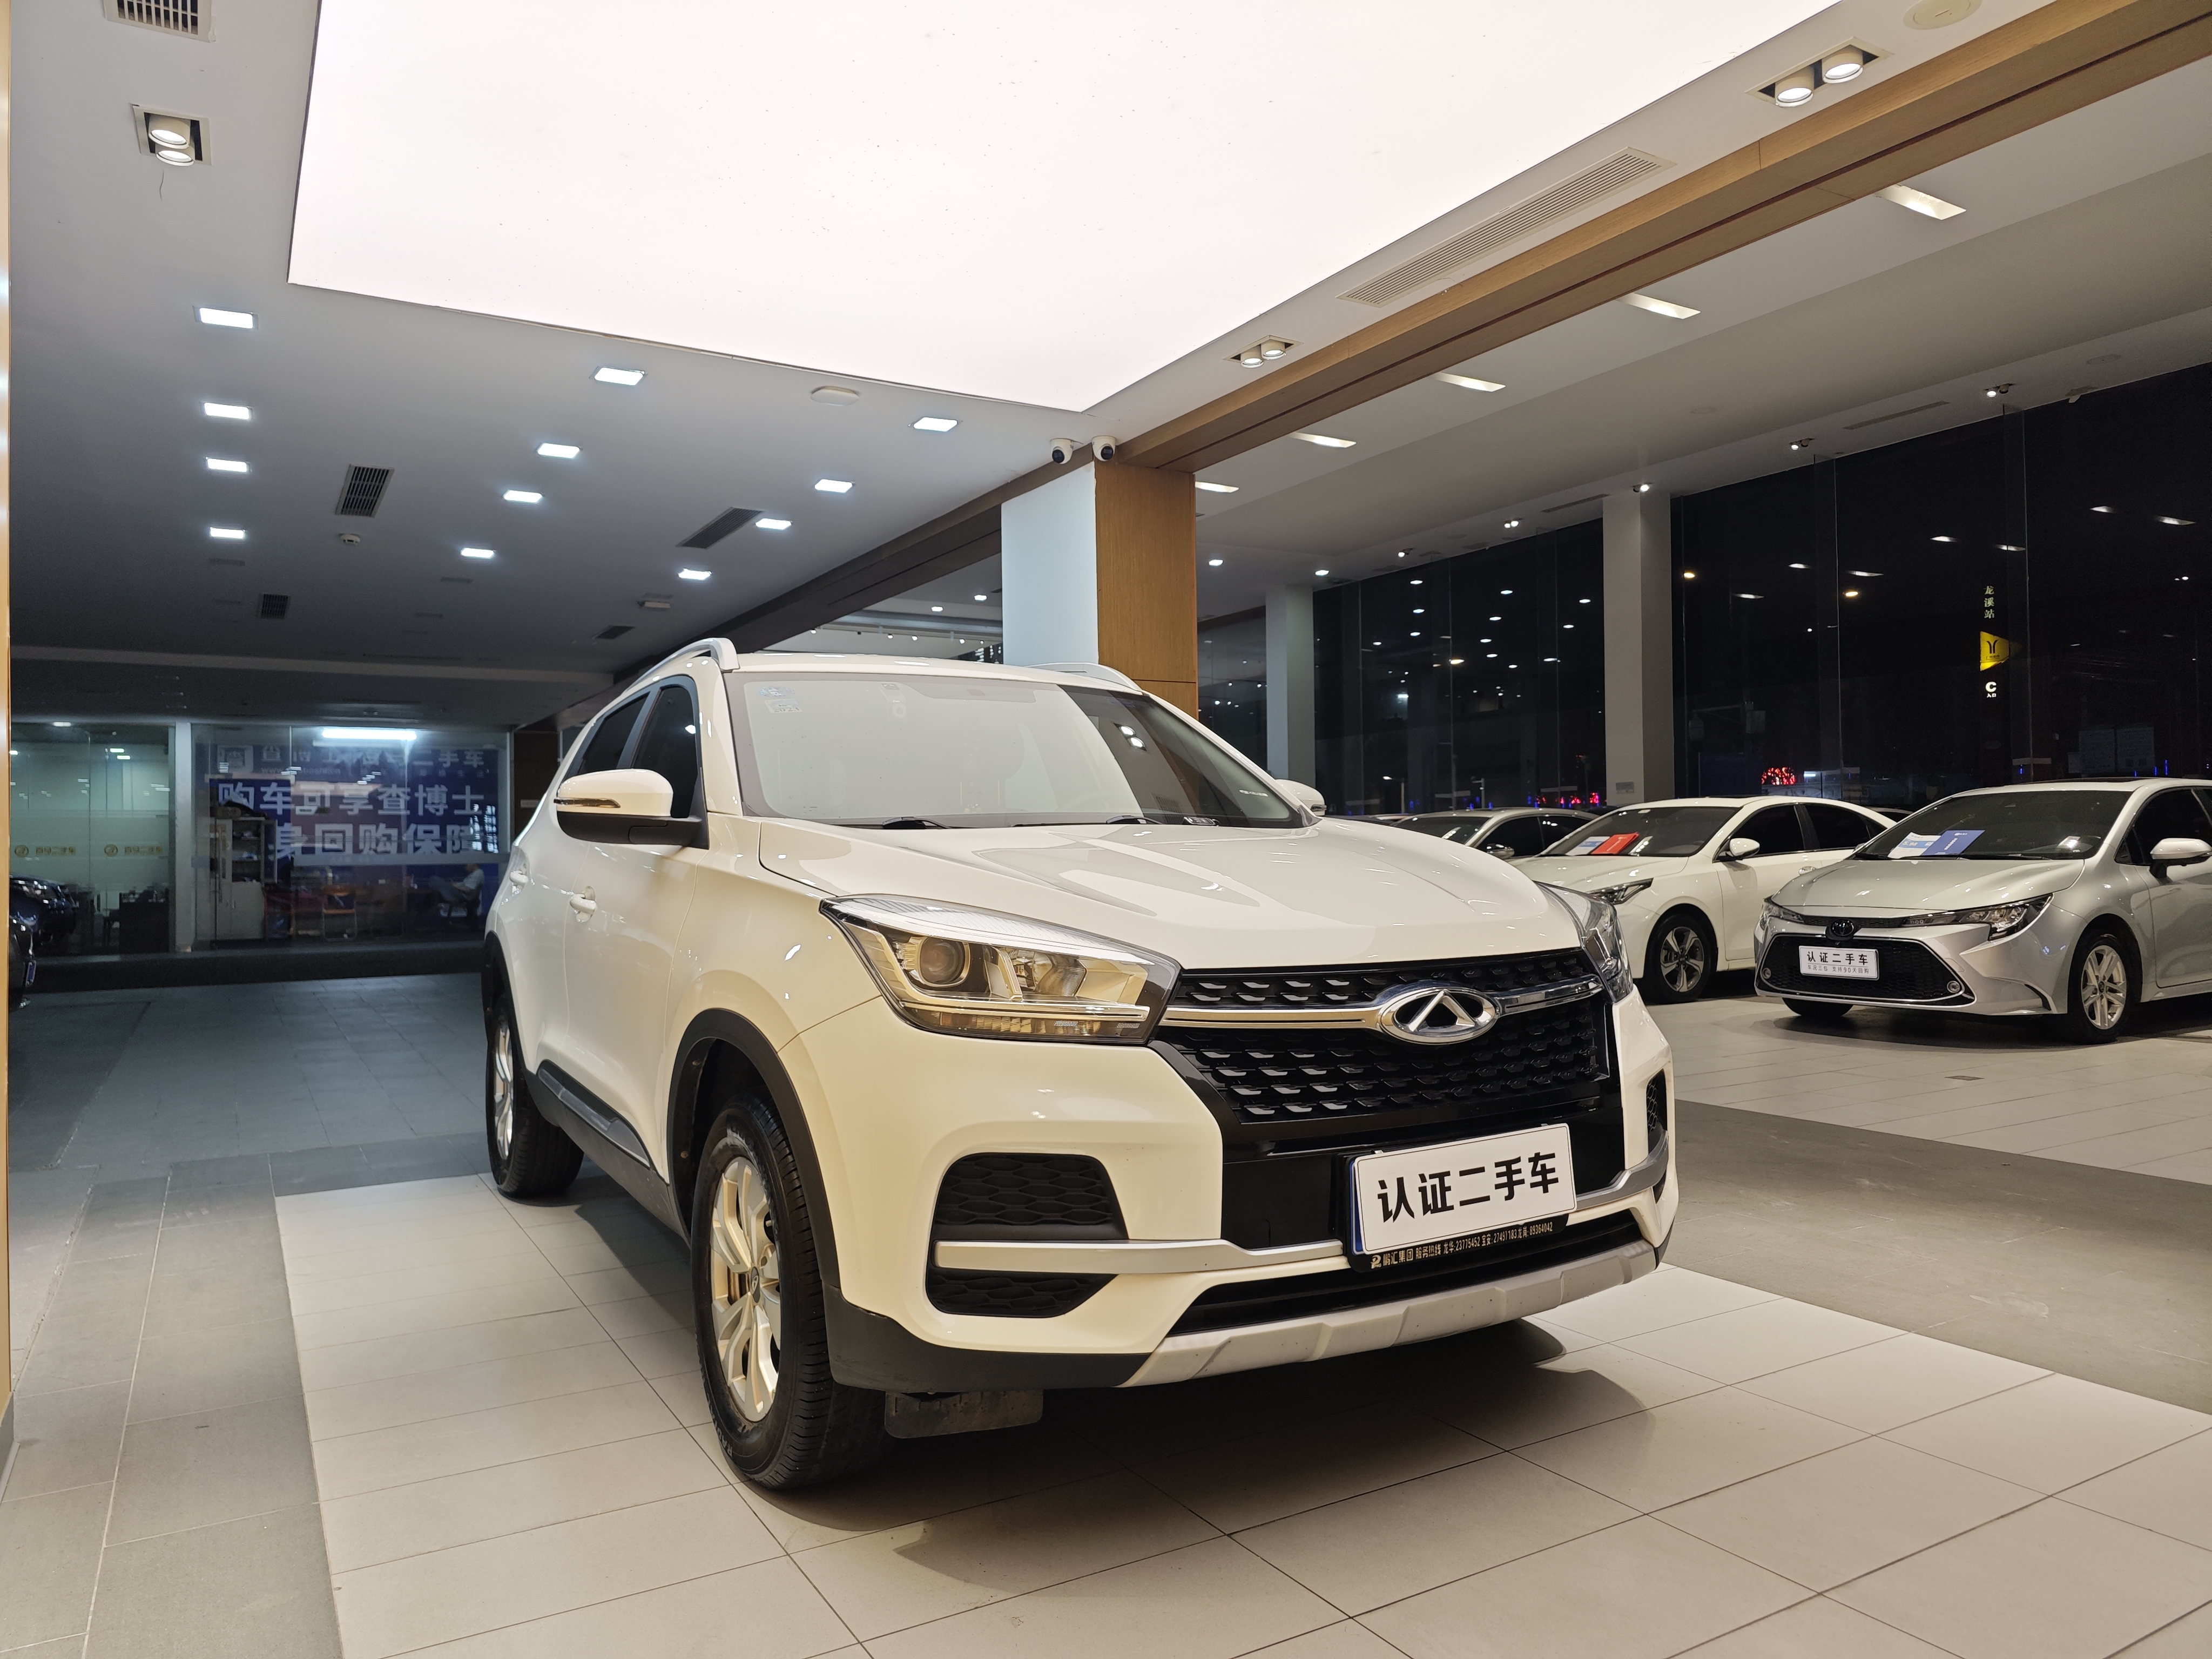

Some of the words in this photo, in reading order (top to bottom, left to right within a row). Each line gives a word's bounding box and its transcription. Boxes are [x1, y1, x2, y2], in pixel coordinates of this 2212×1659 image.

[1984, 585, 1995, 619] 龙溪站
[1985, 682, 1997, 692] C
[218, 781, 484, 816] 购车可享查博士
[1807, 951, 1868, 965] 认证二手车
[1377, 1151, 1559, 1223] 认证二手车
[1382, 1248, 1413, 1266] 鹏汇集团
[1415, 1243, 1441, 1259] 服务热线
[1443, 1236, 1480, 1255] 龙华:23775452
